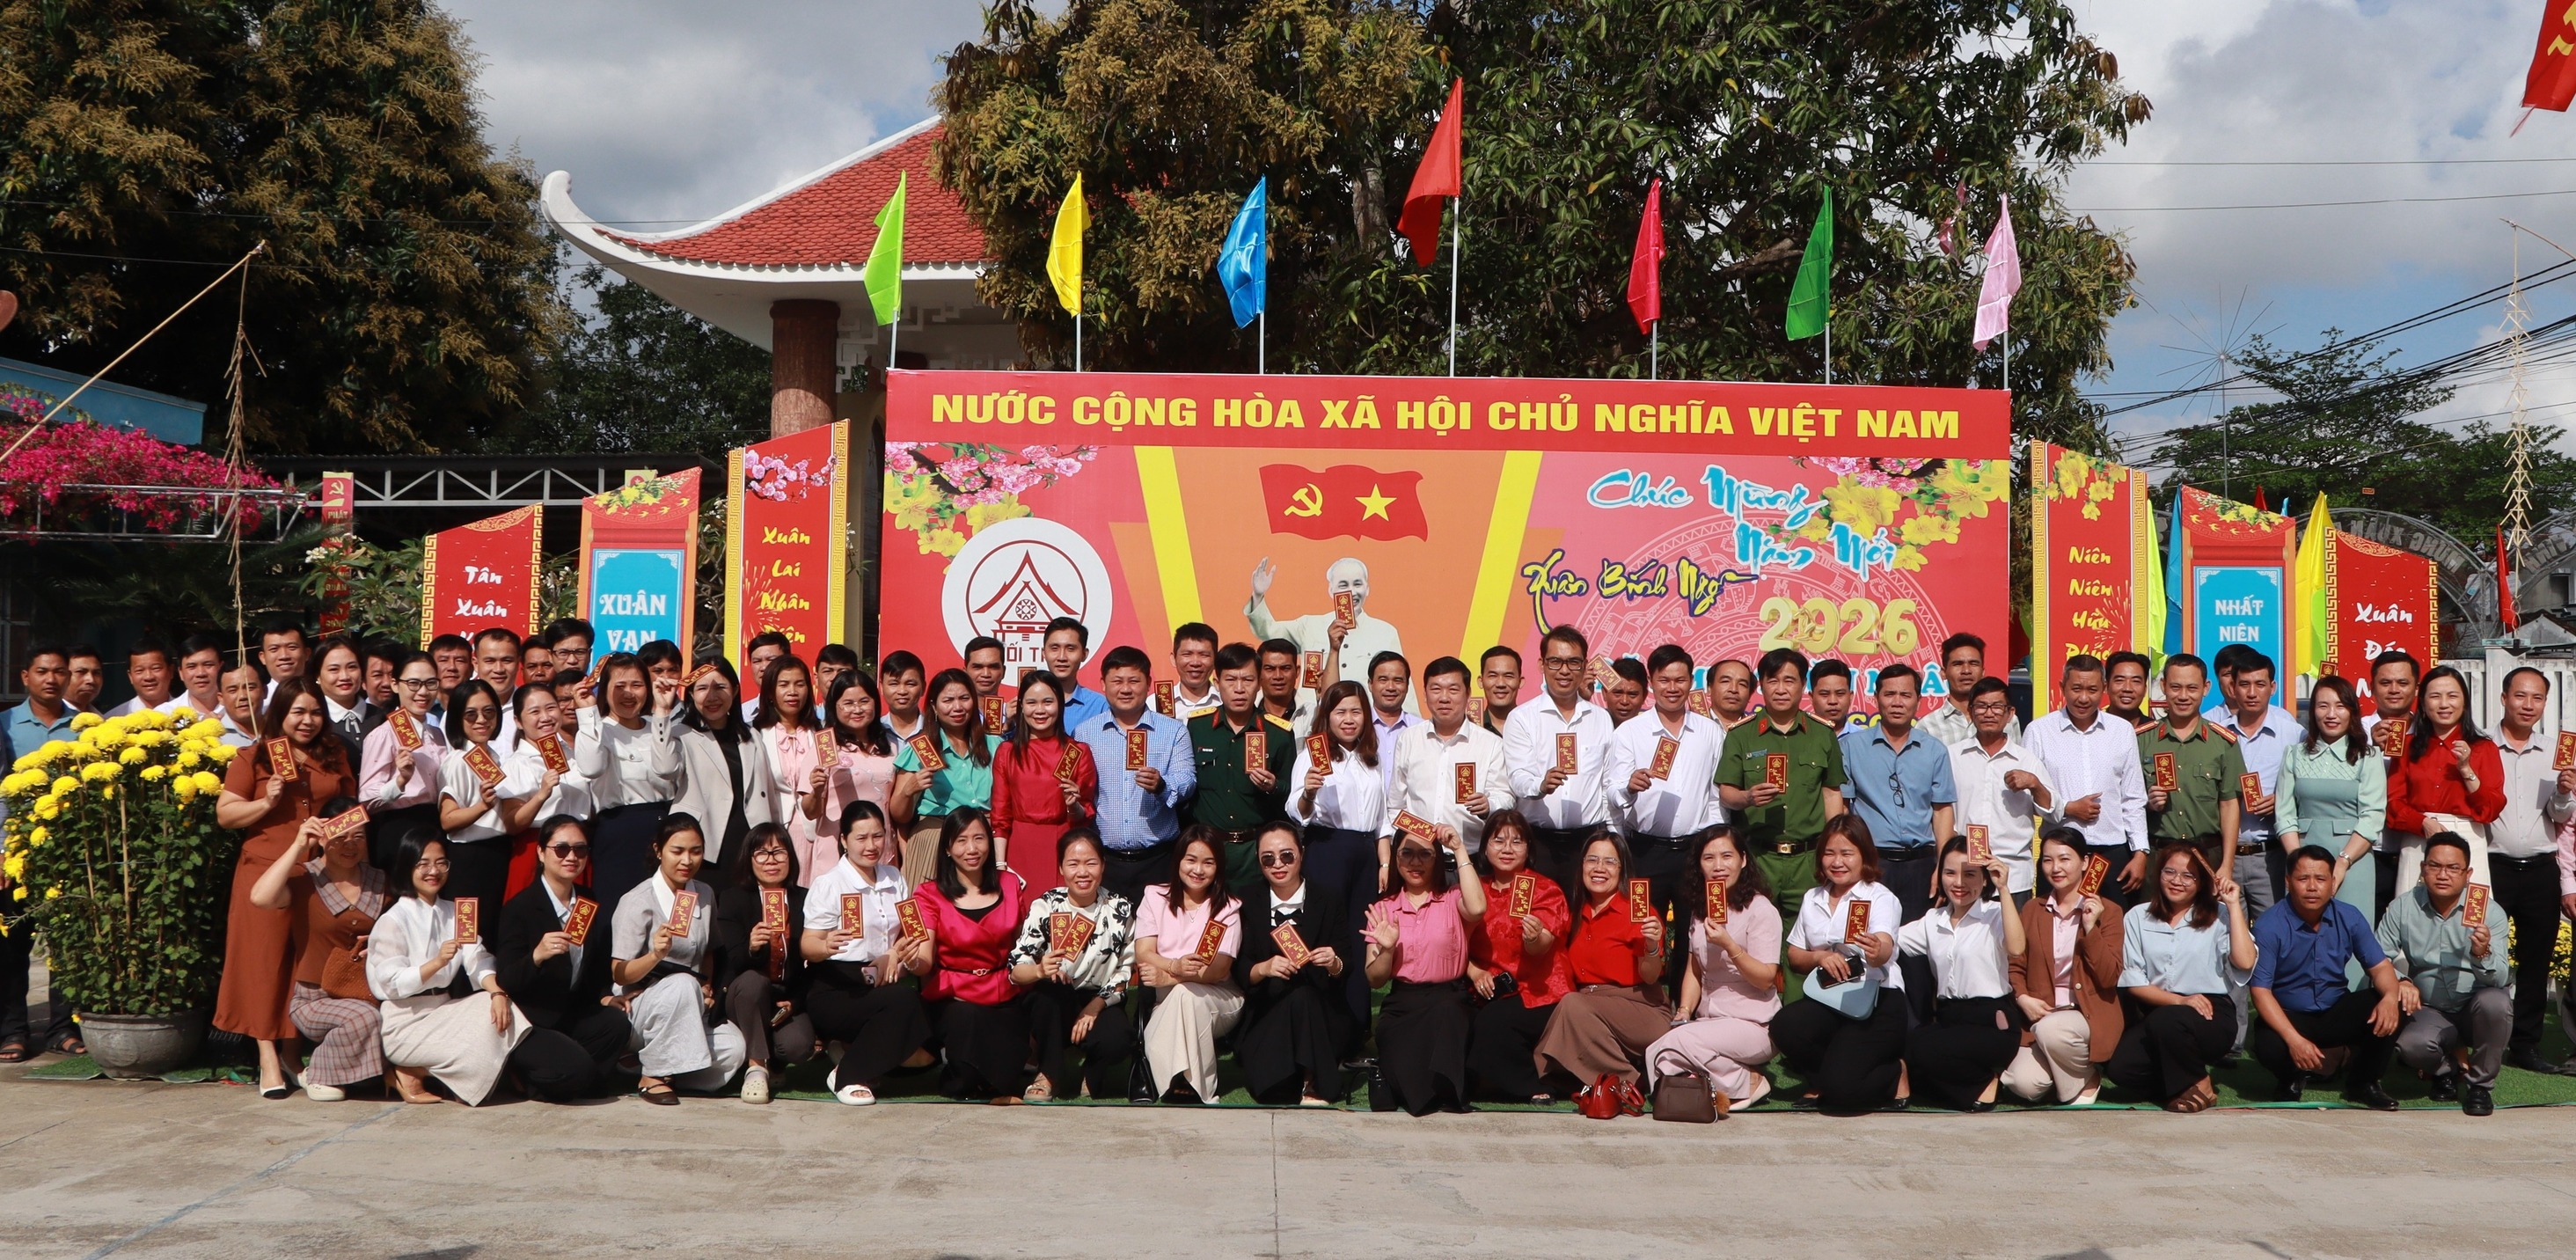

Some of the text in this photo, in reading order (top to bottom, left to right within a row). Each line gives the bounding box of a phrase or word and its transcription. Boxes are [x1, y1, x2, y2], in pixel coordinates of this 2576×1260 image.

[932, 389, 1960, 443] NƯỚC CỘNG HÒA XÃ HỘI CHỦ NGHĨA VIỆT NAM
[1589, 469, 1692, 507] Chúc
[762, 526, 811, 545] Xuân
[1735, 521, 1898, 582] Năm Mới
[2068, 546, 2111, 565] Niên
[464, 565, 504, 585] Tân
[771, 559, 801, 577] Lai
[2068, 578, 2112, 597] Niên
[455, 597, 509, 618] Xuân
[598, 589, 667, 616] XUÂN
[760, 588, 810, 612] Nhân
[2214, 594, 2264, 616] NHẤT
[2071, 607, 2111, 630] Hữu
[2354, 602, 2413, 624] Xuân
[1758, 596, 1919, 656] 2026
[2219, 622, 2259, 642] NIÊN
